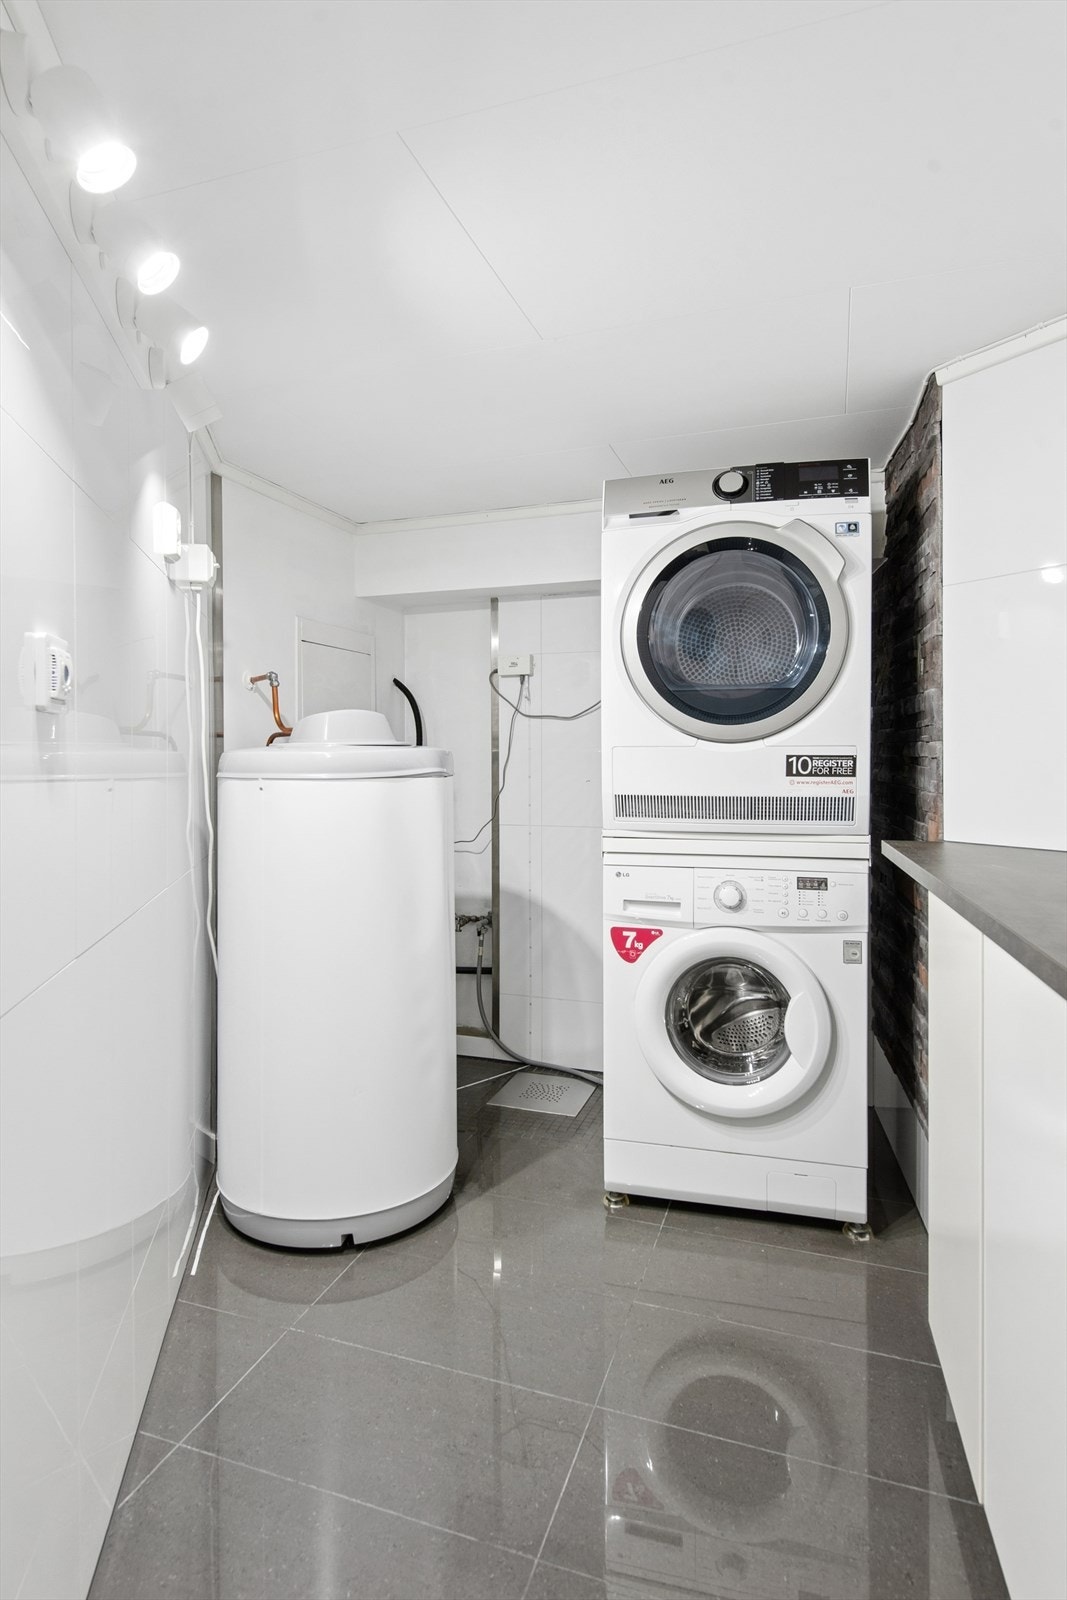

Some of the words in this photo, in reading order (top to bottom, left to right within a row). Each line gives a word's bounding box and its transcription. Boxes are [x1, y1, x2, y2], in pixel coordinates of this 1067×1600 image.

[788, 756, 812, 775] 10
[812, 760, 853, 768] REGISTER
[812, 767, 829, 775] FOR
[832, 767, 853, 775] FREE
